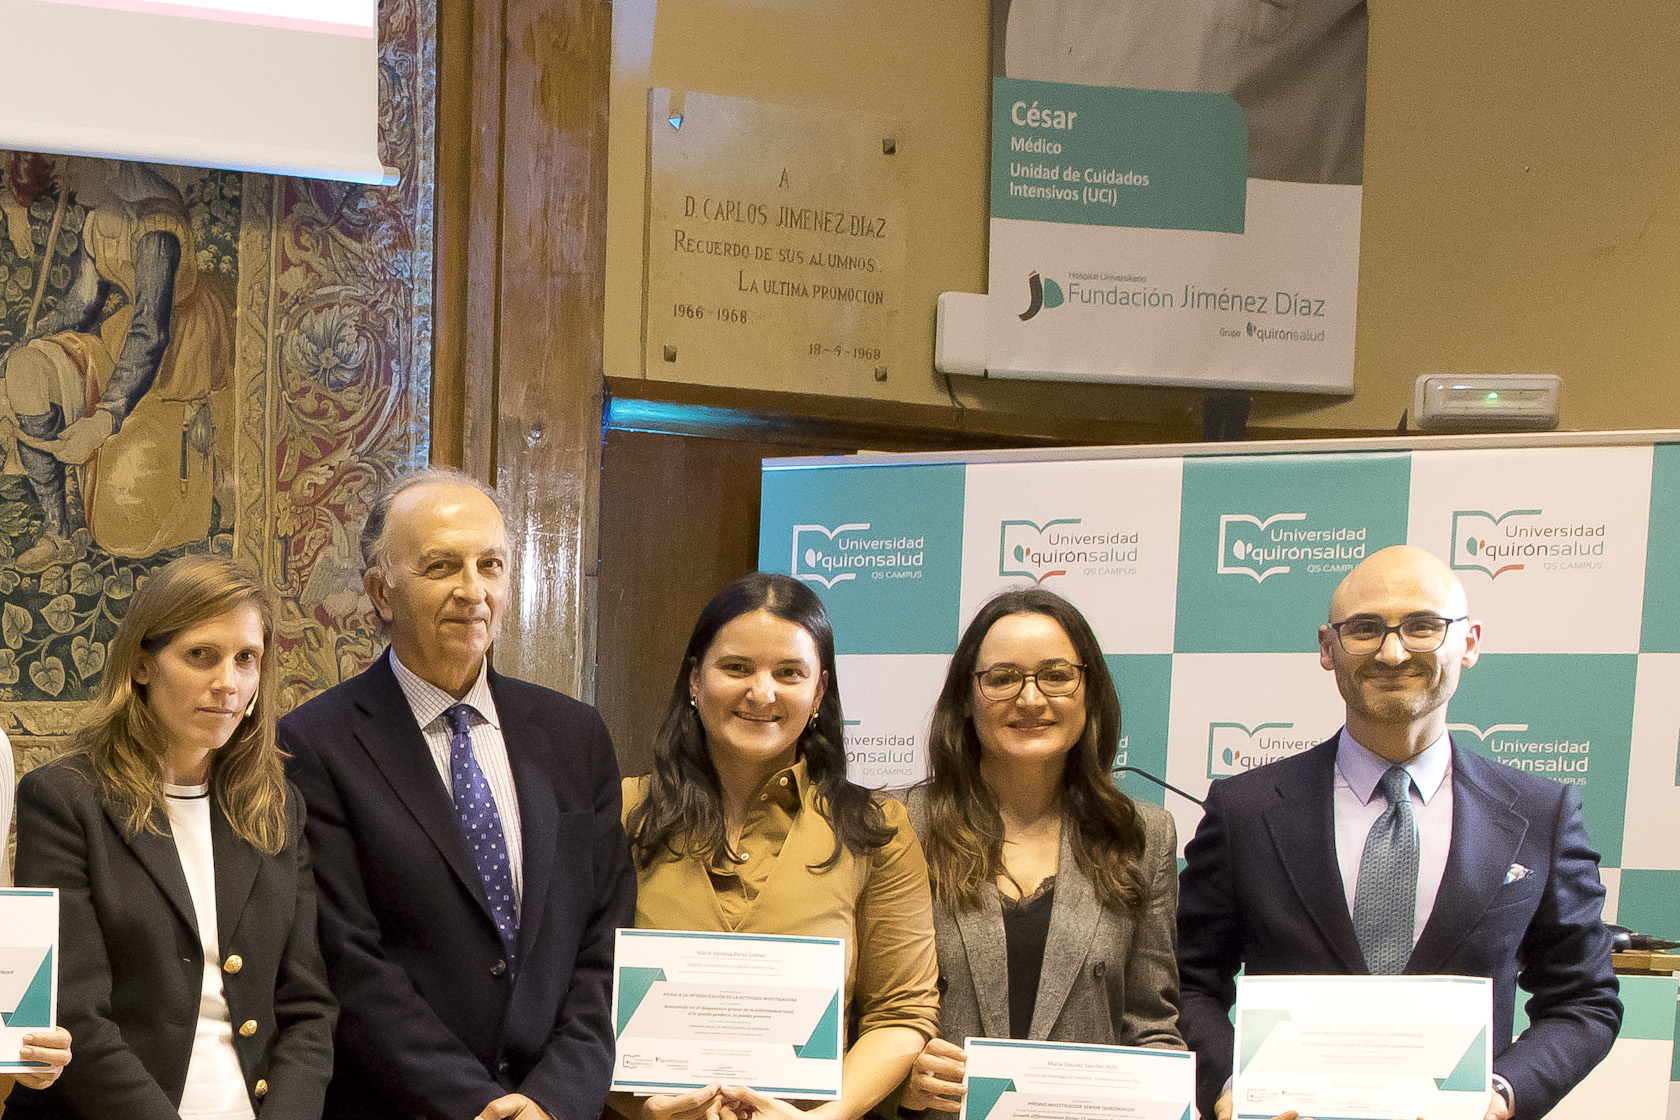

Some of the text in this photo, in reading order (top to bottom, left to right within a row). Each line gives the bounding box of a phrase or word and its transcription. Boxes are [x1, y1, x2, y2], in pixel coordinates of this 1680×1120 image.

[1011, 101, 1078, 131] César
[1011, 136, 1063, 155] Médico
[778, 168, 790, 189] A
[1010, 162, 1150, 187] Unidad de Cuidados
[1010, 182, 1118, 208] Intensivos (UCI)
[703, 198, 768, 226] CARLOS
[755, 246, 773, 262] DE
[779, 250, 805, 265] SUS
[1069, 272, 1147, 284] Hospital Universitario
[763, 279, 809, 299] ULTIMA
[813, 285, 885, 305] PROMOCION
[1069, 283, 1326, 318] Fundación Jiménez Díaz
[1219, 328, 1326, 343] Grupo quirónsalud
[1048, 532, 1139, 546] Universidad
[1270, 527, 1367, 544] Universidad
[1506, 524, 1606, 539] Universidad
[838, 537, 925, 552] Universidad
[1251, 543, 1367, 564] quirónsalud
[1486, 541, 1604, 563] quirónsalud
[822, 552, 924, 571] quirónsalud
[1031, 547, 1139, 568] quirónsalud
[1543, 560, 1604, 572] QS CAMPUS
[871, 570, 923, 581] QS CAMPUS
[1083, 567, 1138, 578] QS CAMPUS
[1307, 564, 1322, 575] QS
[1491, 739, 1591, 755] Universidad
[876, 767, 914, 777] CAMPUS
